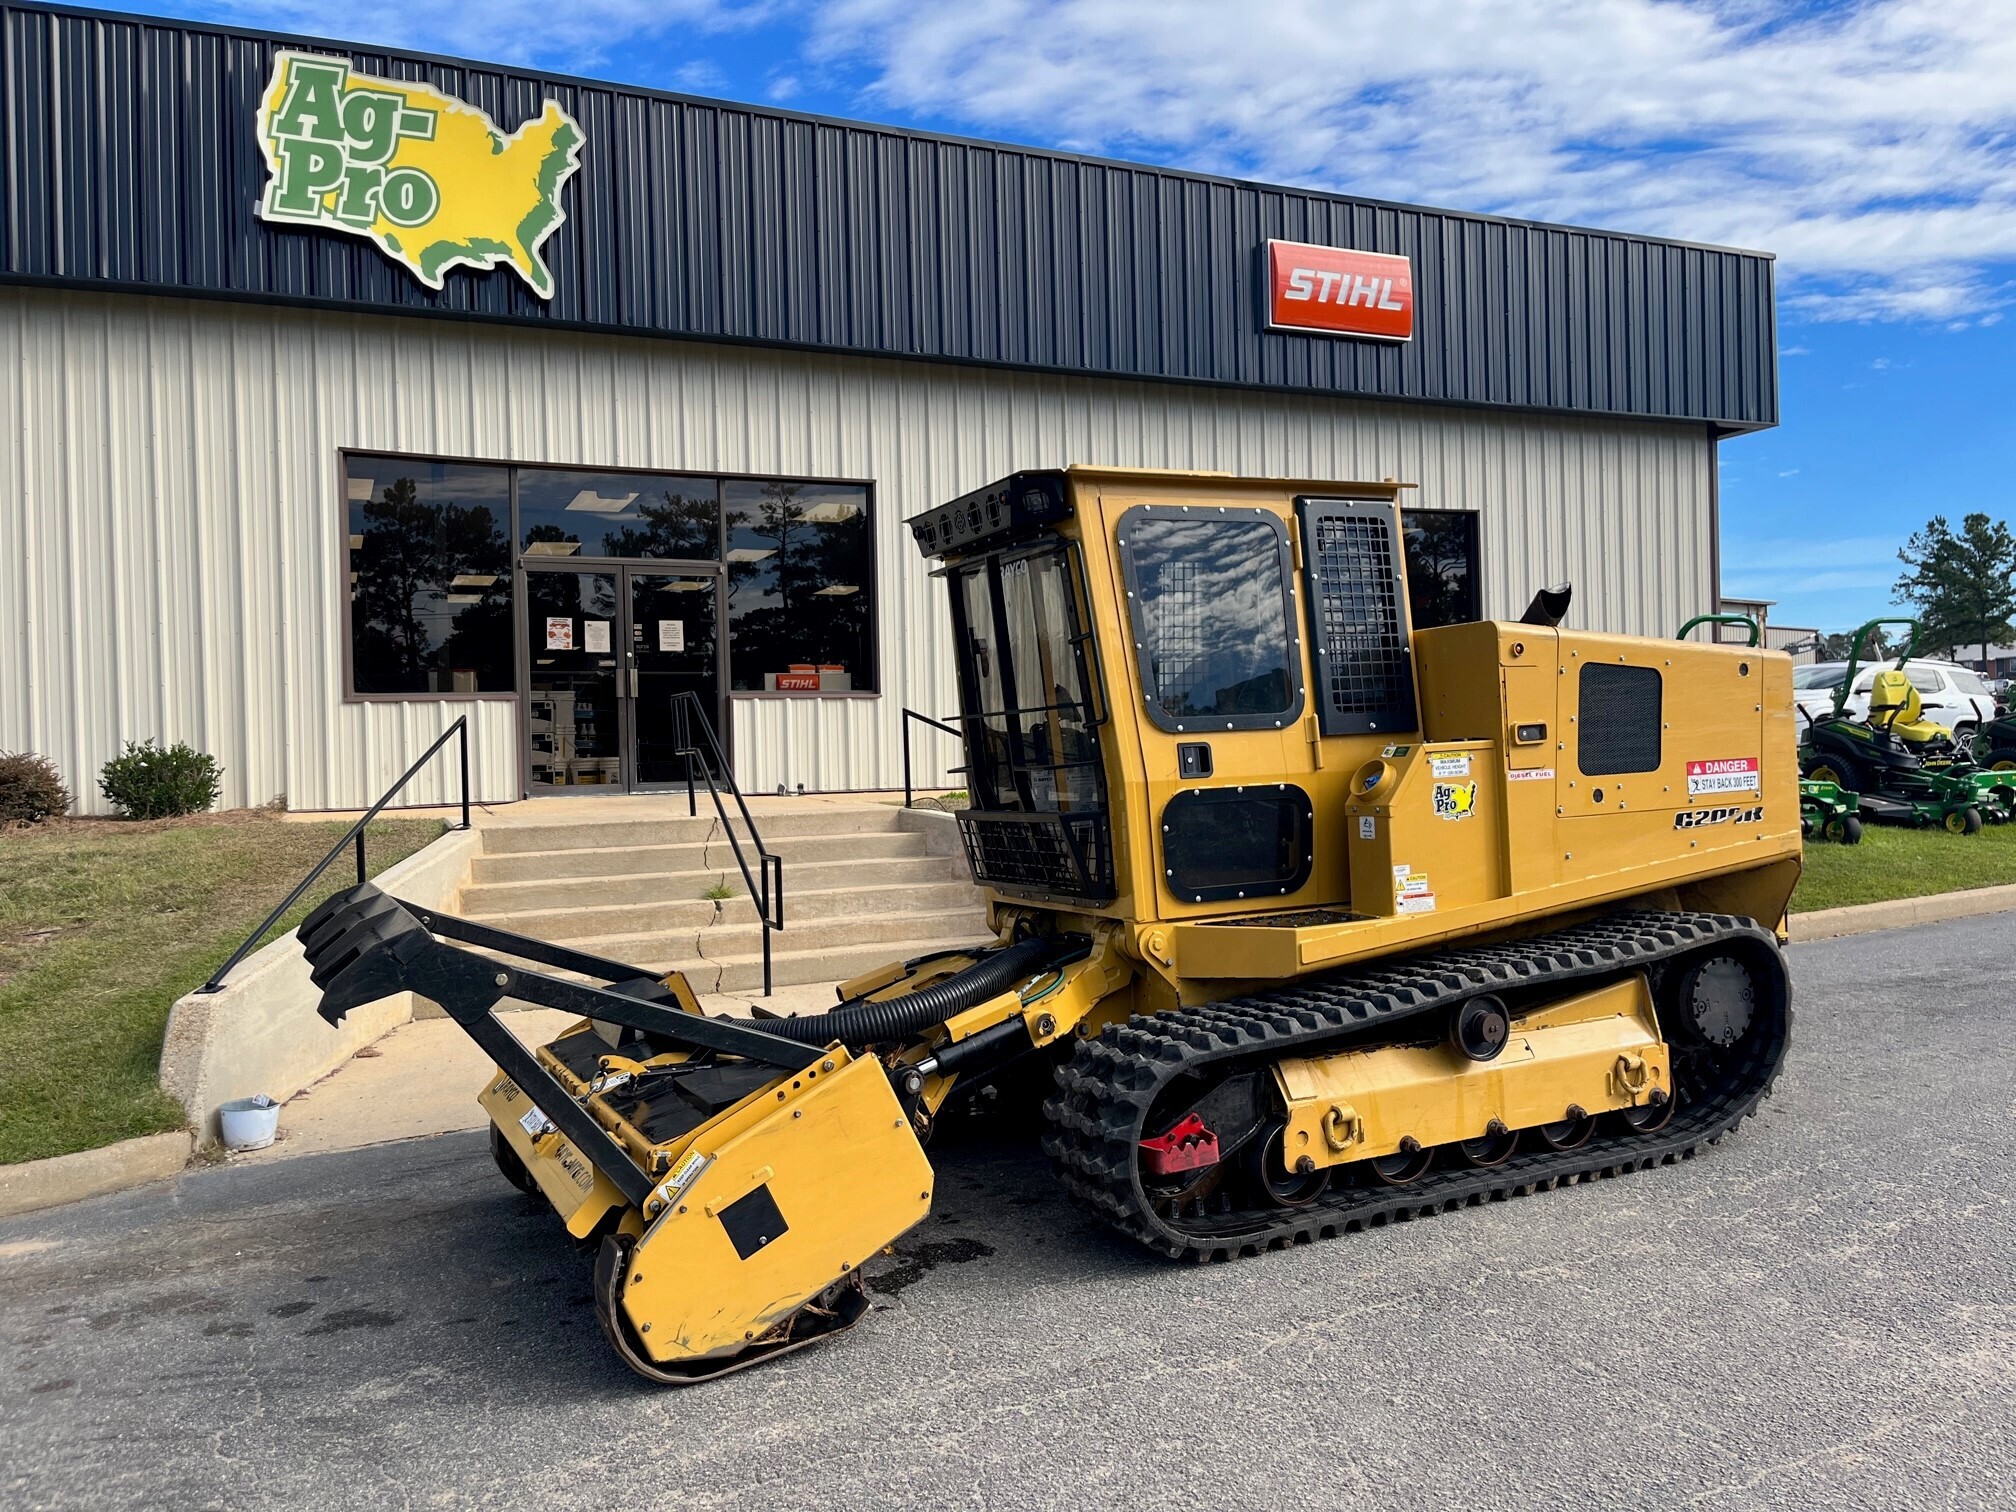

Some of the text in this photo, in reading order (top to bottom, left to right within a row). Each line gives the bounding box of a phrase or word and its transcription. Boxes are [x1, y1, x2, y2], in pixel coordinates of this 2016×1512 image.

[271, 60, 436, 162] Ag-
[273, 138, 437, 225] Pro
[1284, 267, 1404, 311] STIHL
[781, 680, 816, 688] STIHL
[1705, 759, 1748, 773] DANGER
[1702, 776, 1756, 790] STAY BACK 300 FEET
[1435, 785, 1455, 800] Ag-
[1436, 799, 1457, 812] Pro
